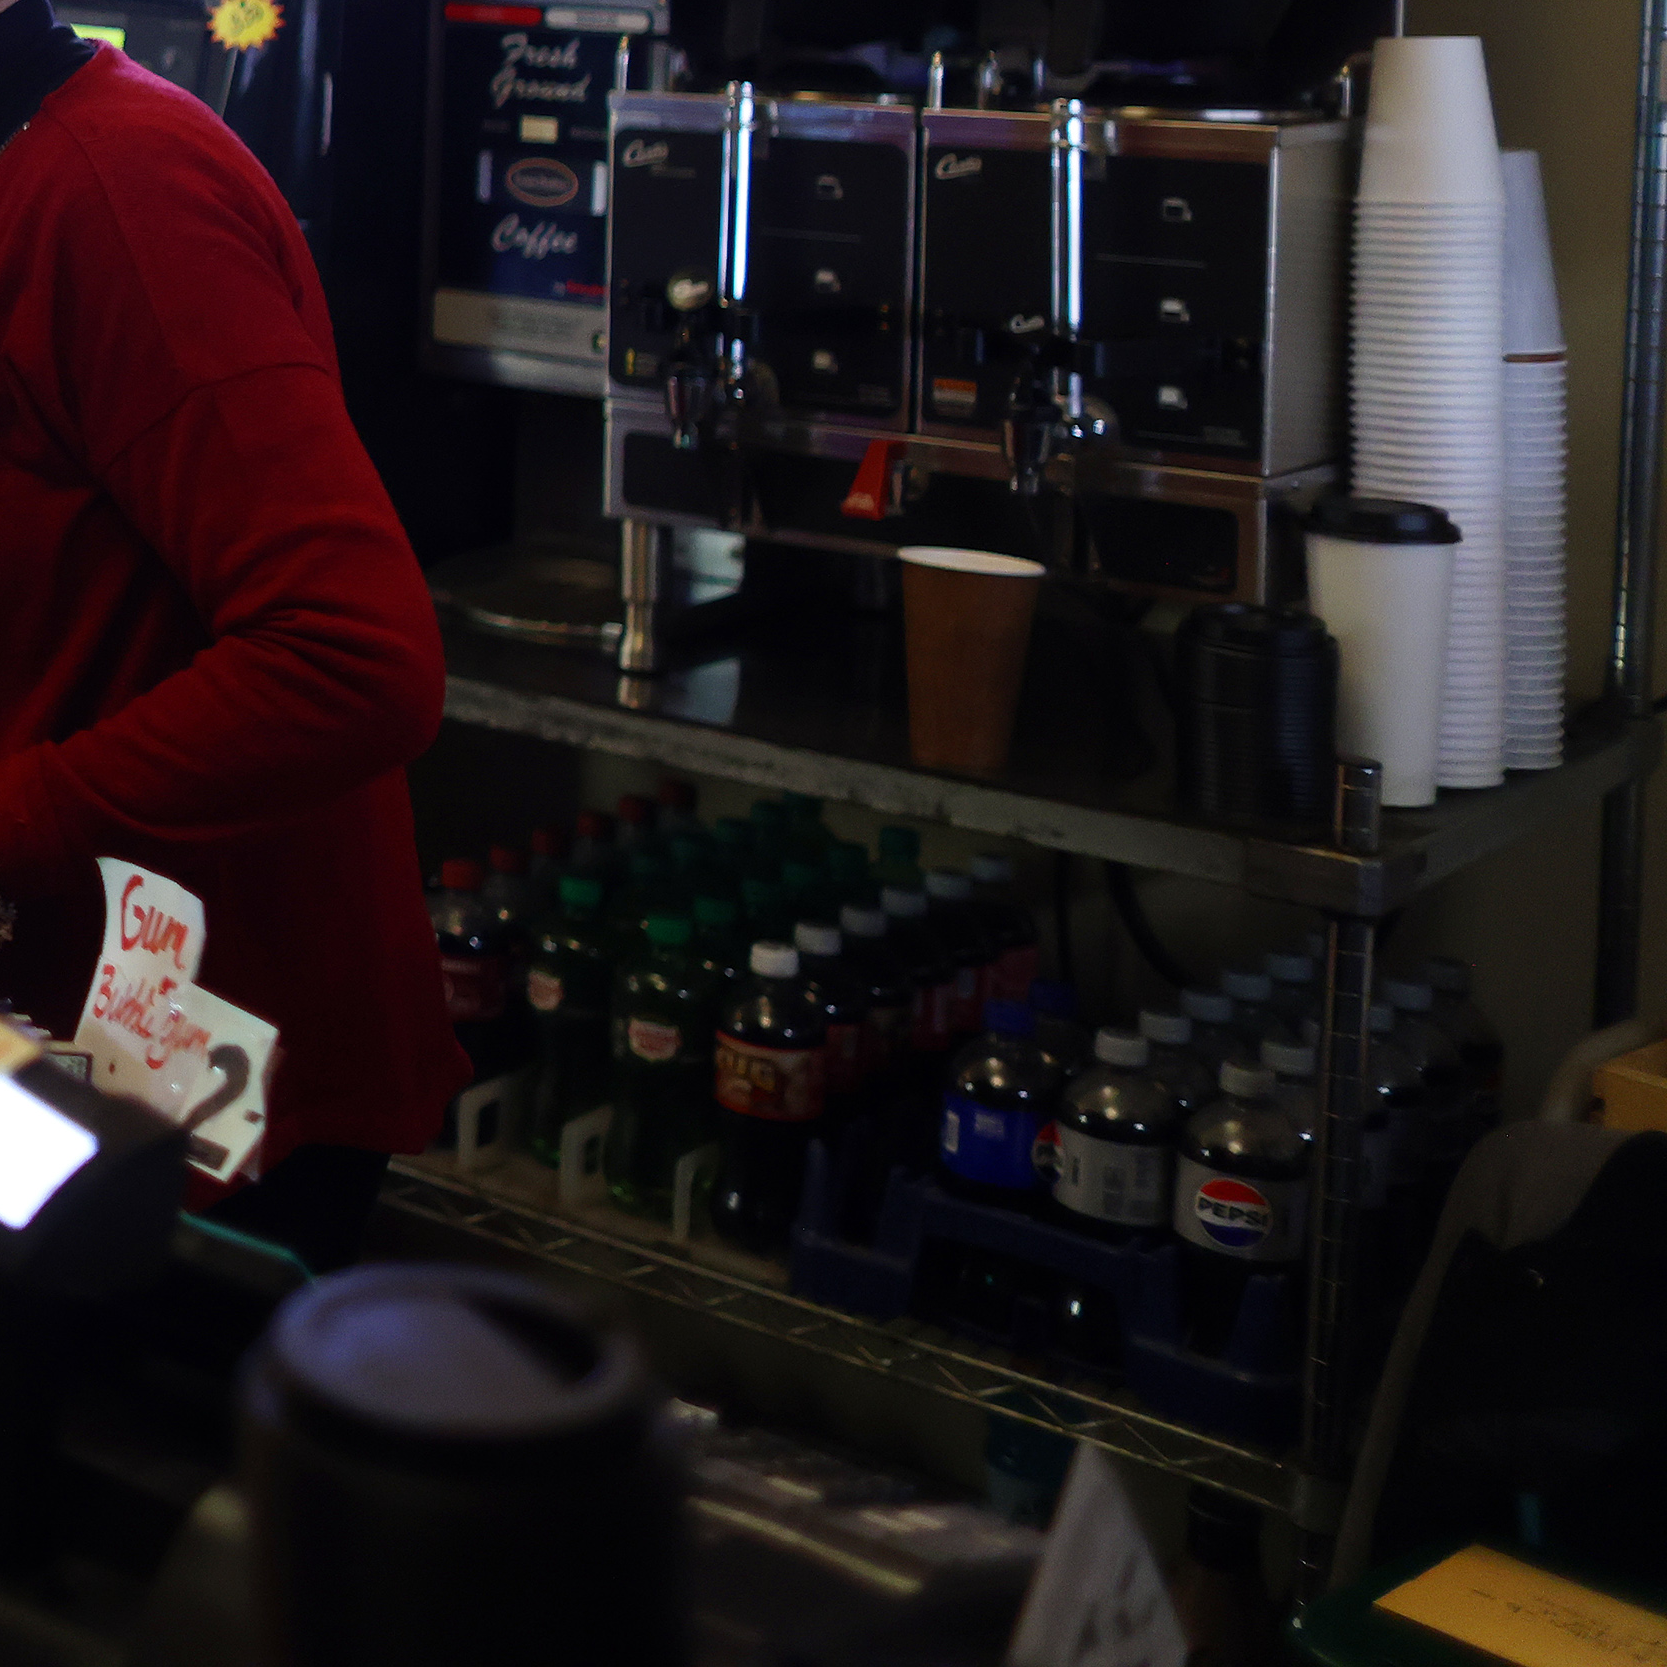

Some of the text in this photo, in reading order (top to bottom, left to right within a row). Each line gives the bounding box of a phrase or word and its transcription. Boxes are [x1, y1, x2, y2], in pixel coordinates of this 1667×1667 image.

[500, 32, 581, 69] Fresh
[490, 65, 593, 110] Ground
[490, 212, 578, 260] Coffee
[120, 874, 189, 971] Gum
